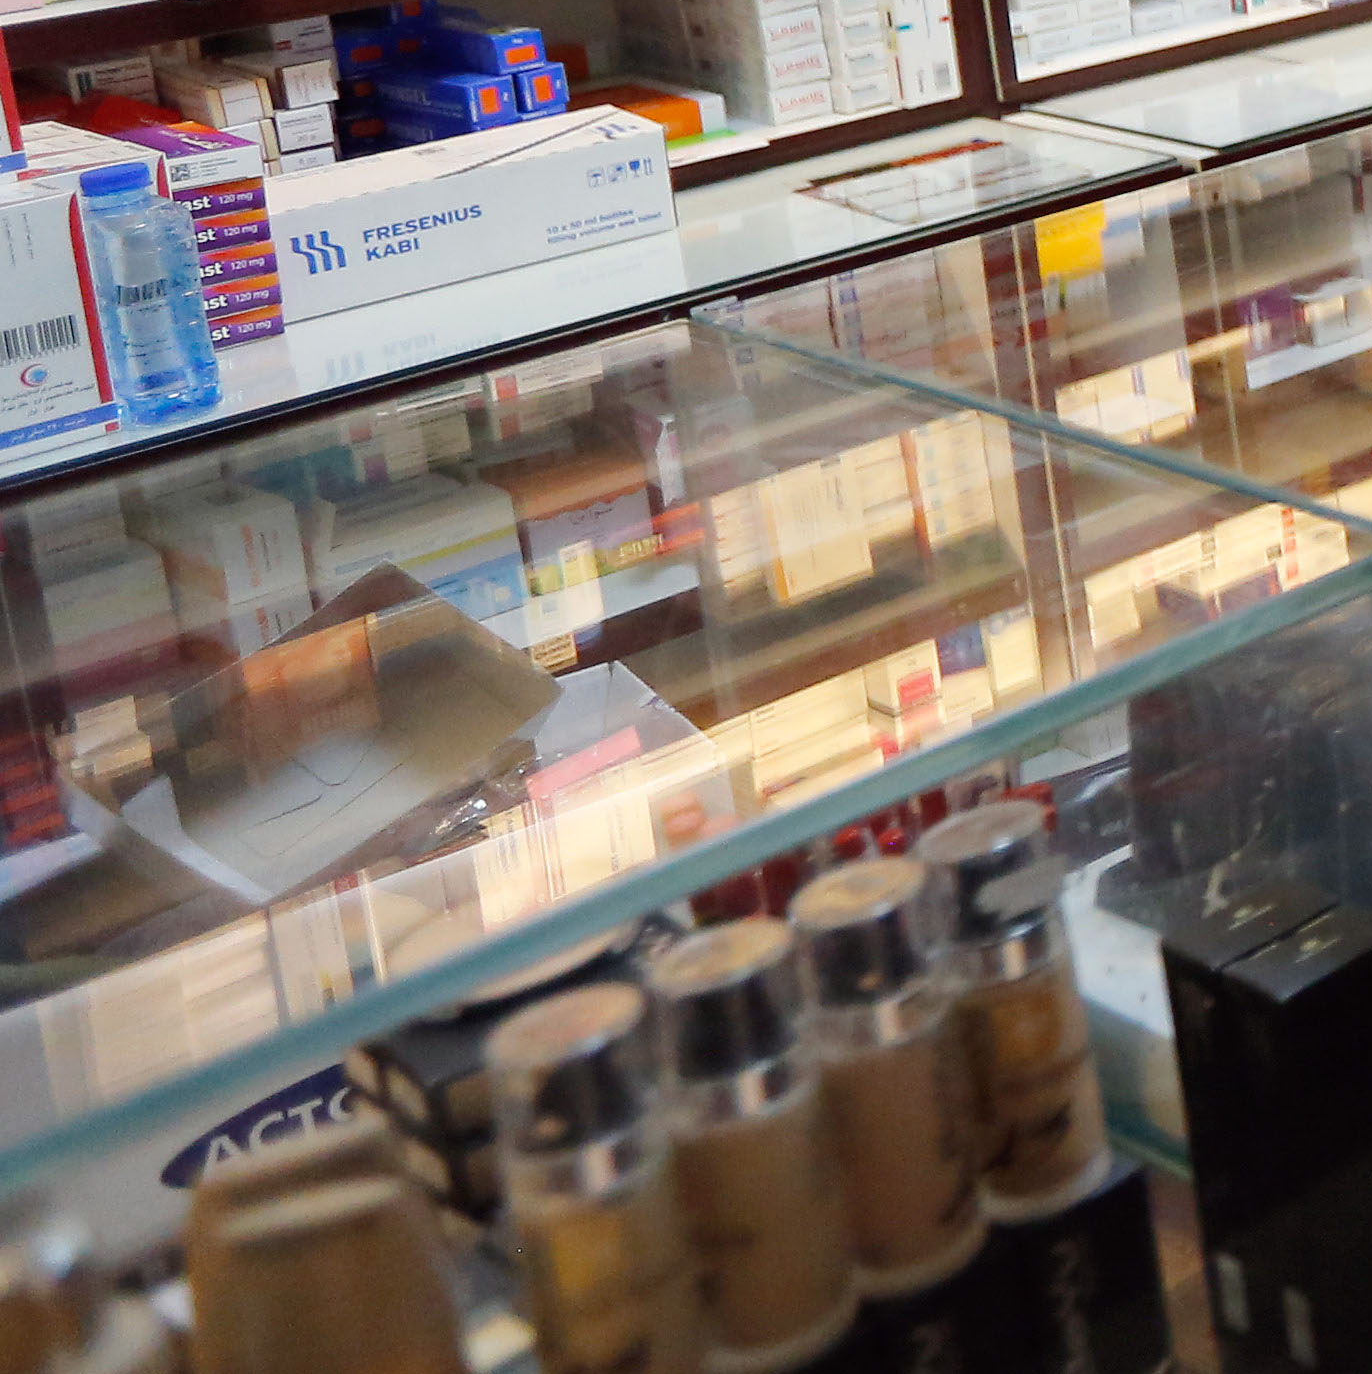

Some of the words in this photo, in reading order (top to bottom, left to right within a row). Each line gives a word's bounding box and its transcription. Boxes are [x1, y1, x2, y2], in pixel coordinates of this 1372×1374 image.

[218, 193, 235, 205] 120
[236, 191, 253, 203] mg
[223, 226, 239, 237] 120
[241, 224, 258, 236] mg
[362, 204, 483, 243] FRESENIUS
[366, 238, 420, 262] KABI
[230, 258, 247, 270] 120
[248, 256, 265, 269] mg
[235, 291, 251, 303] 120
[253, 288, 270, 301] mg
[238, 321, 254, 333] 120
[255, 319, 272, 332] mg
